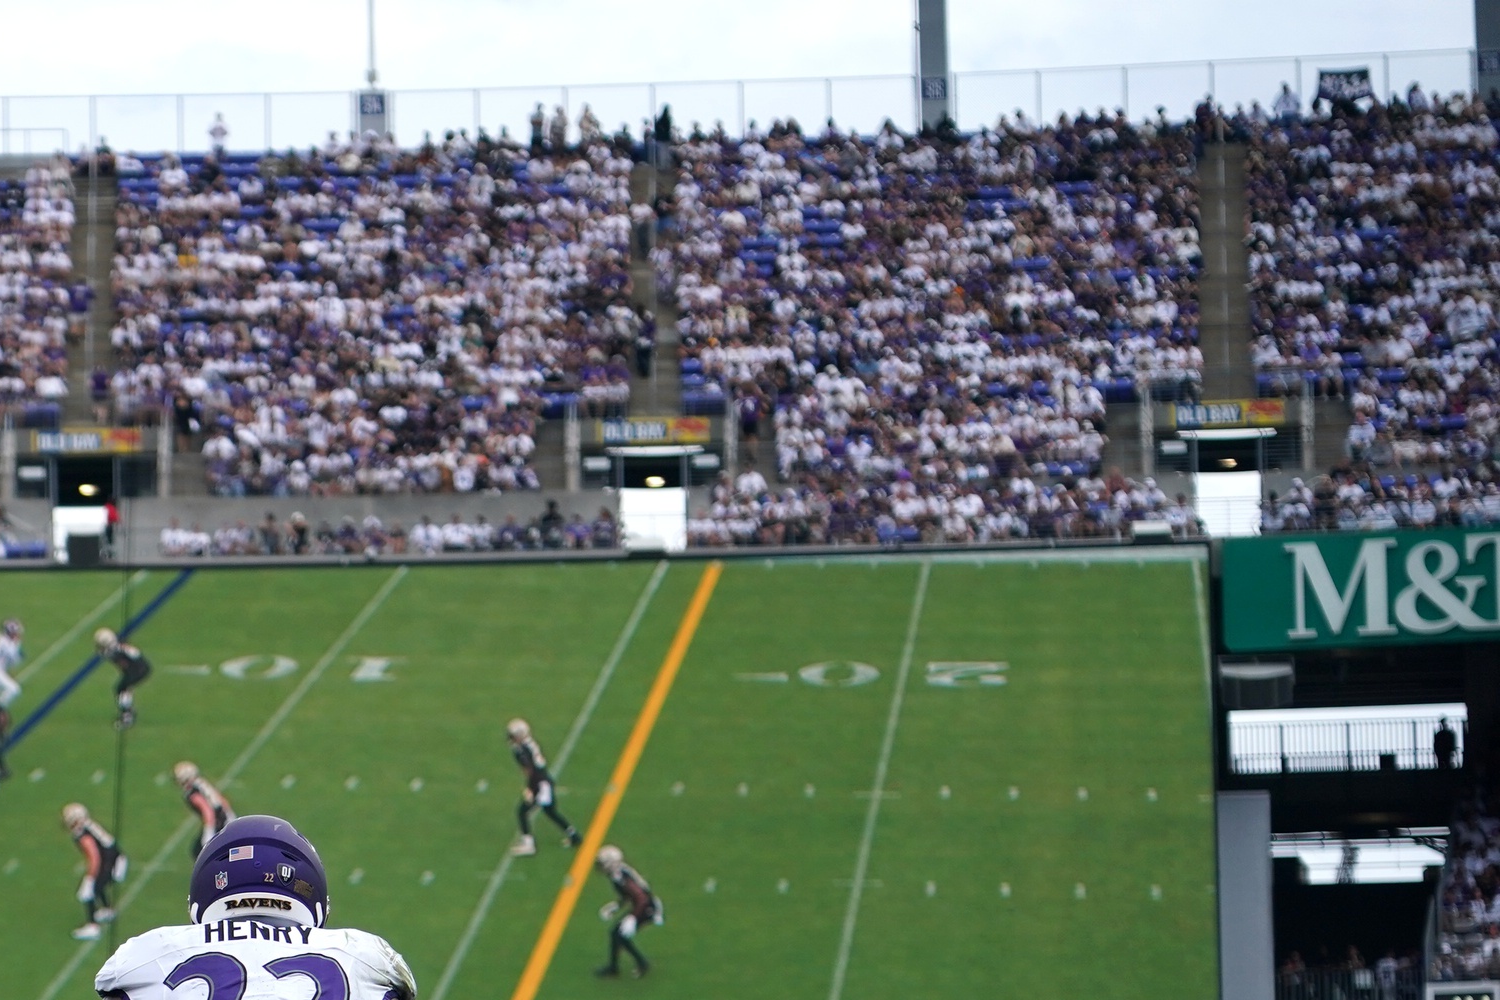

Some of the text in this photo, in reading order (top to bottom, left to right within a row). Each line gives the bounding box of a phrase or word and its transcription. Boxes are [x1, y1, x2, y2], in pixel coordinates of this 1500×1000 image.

[1209, 403, 1240, 423] BAY
[264, 873, 274, 882] 22
[225, 898, 292, 910] RAVENS
[204, 920, 312, 944] HENRY
